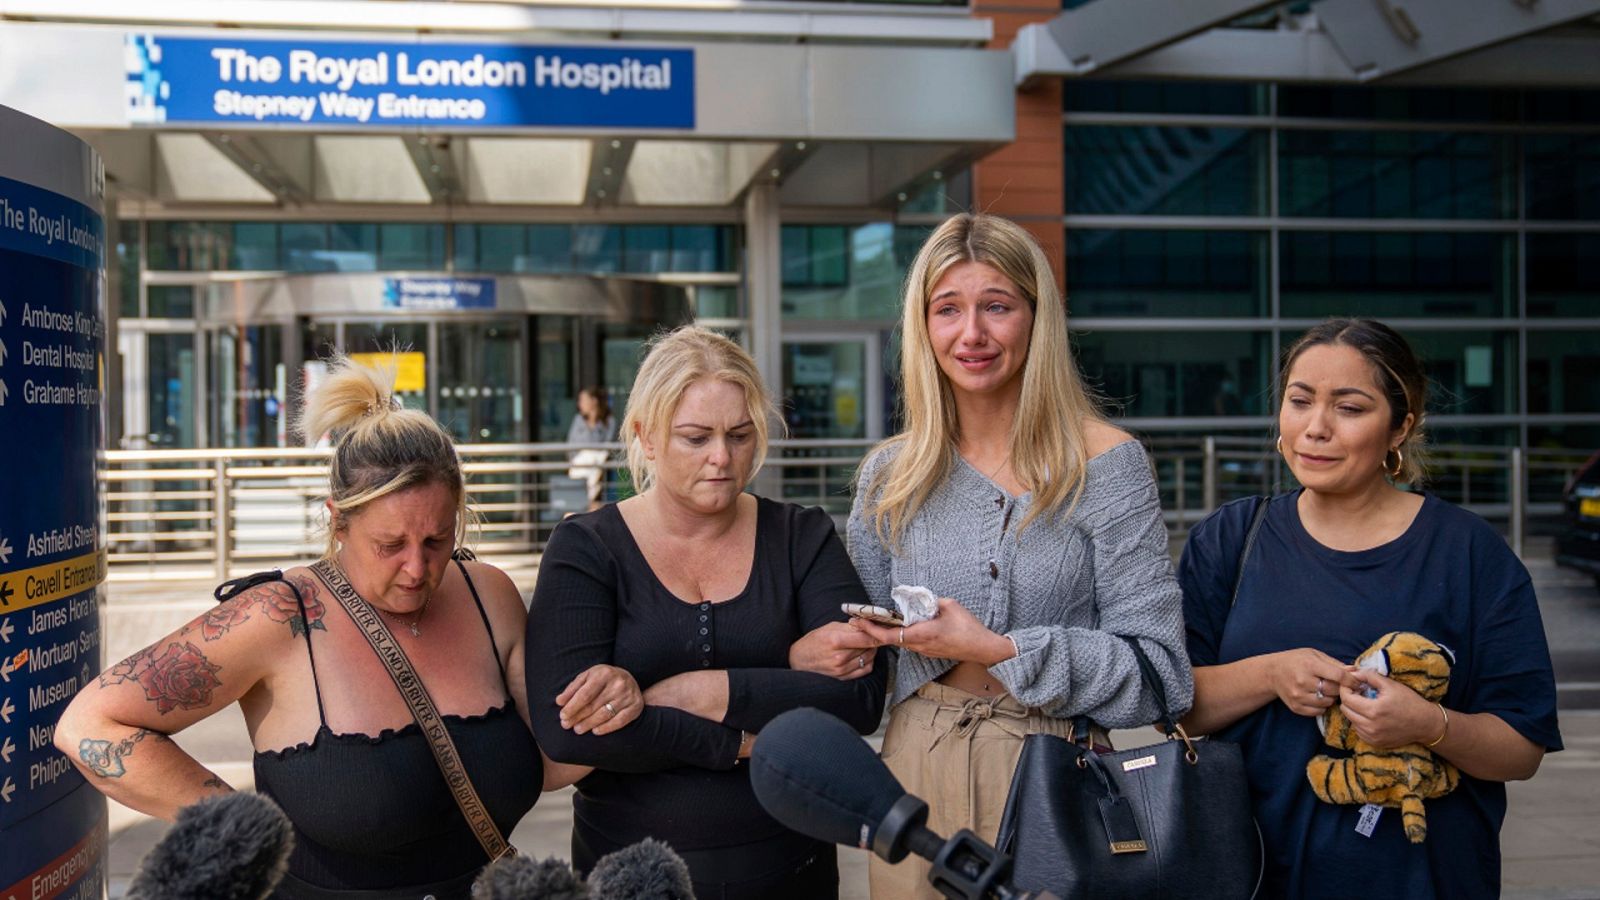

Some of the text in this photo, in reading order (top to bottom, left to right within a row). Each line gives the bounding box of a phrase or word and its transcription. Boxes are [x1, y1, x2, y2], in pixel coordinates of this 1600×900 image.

[211, 48, 671, 95] The Royal London Hospital
[213, 89, 486, 122] Stepney Way Entrance
[29, 206, 65, 245] Royal
[67, 219, 96, 253] London
[22, 302, 73, 333] Ambrose
[74, 311, 91, 341] King
[23, 341, 95, 374] Dental Hospital
[24, 378, 75, 405] Grahame
[27, 526, 72, 558] Ashfield
[25, 569, 60, 600] Cavell
[28, 607, 67, 635] James
[348, 596, 403, 672] RIVER ISLAND
[29, 639, 79, 673] Mortuary
[29, 676, 77, 713] Museum
[408, 688, 456, 770] RIVER ISLAND
[457, 787, 501, 854] RIVER ISLAND
[31, 847, 89, 900] Emergency
